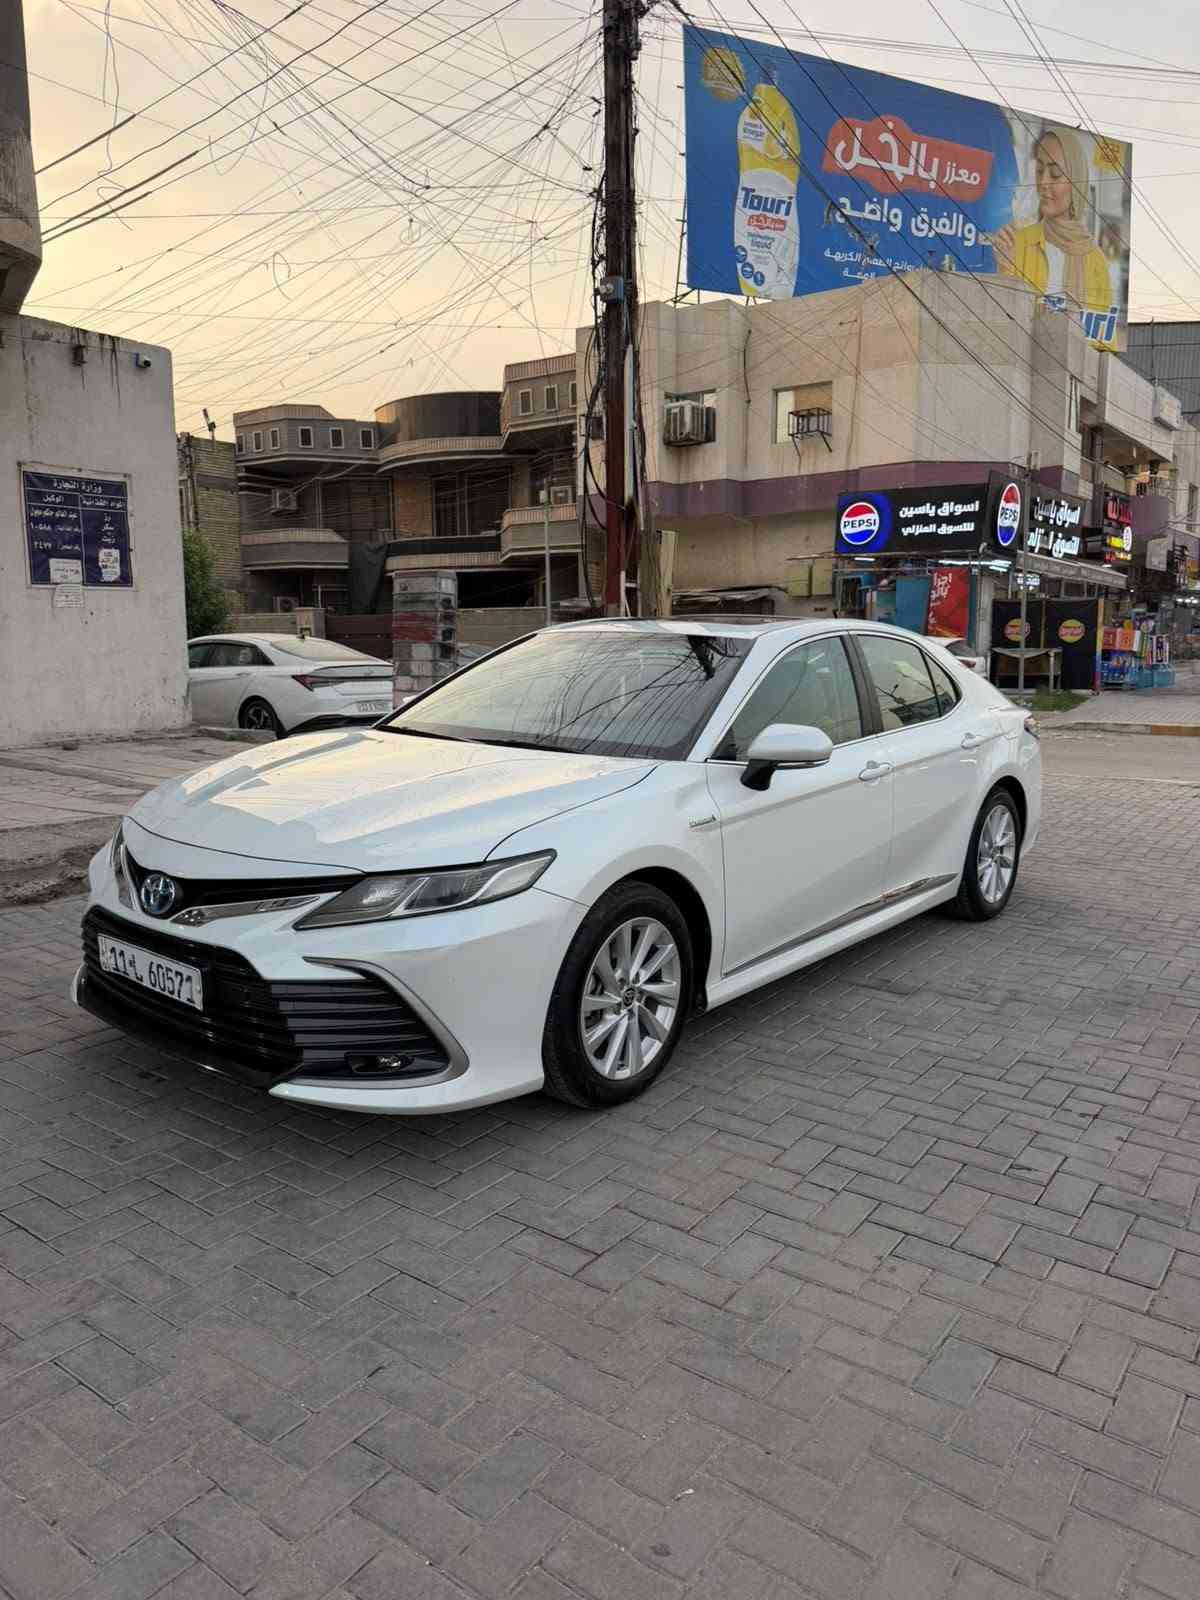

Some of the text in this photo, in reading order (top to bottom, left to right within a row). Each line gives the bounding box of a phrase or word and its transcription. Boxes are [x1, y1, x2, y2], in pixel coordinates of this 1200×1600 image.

[943, 160, 981, 186] معزز
[741, 187, 793, 216] Touri
[911, 208, 977, 247] والفرق
[899, 500, 980, 518] اسواق ياسين
[843, 518, 877, 529] PEPSI
[149, 960, 196, 1005] 60571
